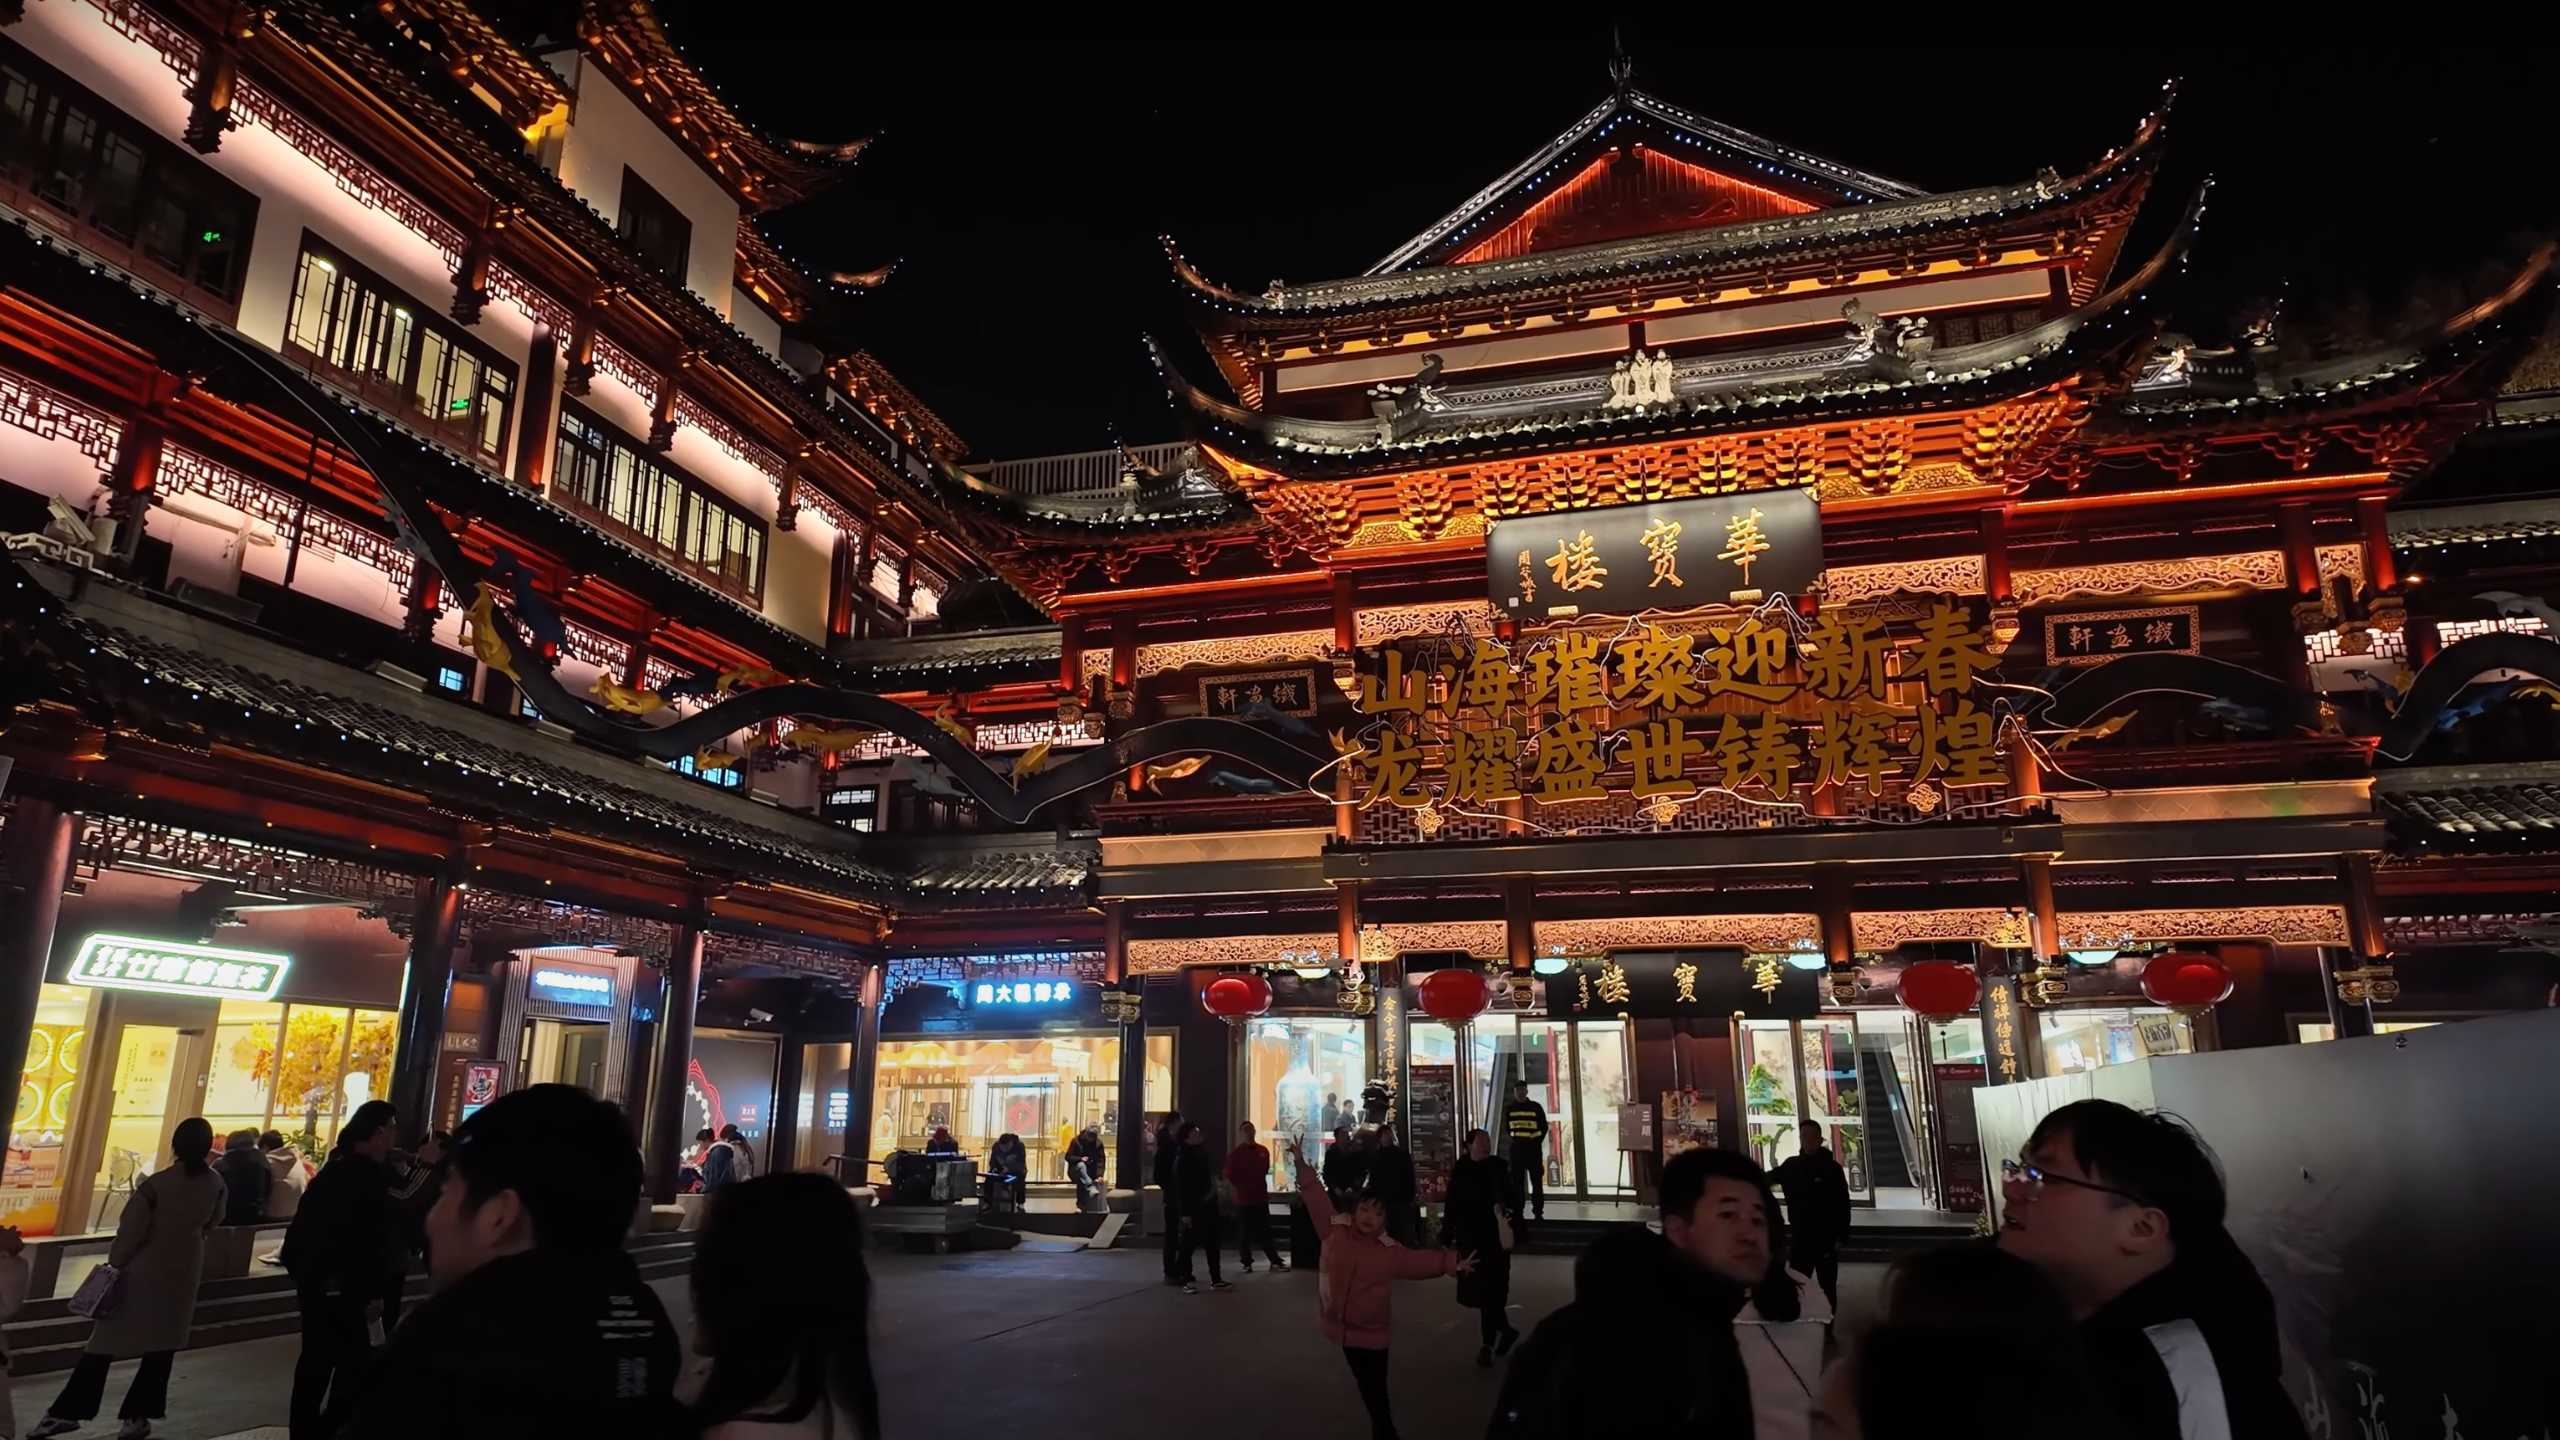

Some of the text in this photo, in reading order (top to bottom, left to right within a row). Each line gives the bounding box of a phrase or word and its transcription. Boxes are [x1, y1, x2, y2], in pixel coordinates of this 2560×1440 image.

[1361, 604, 2001, 719] 山海璀璨迎新春
[1357, 699, 2011, 811] 龙耀盛世铸辉煌
